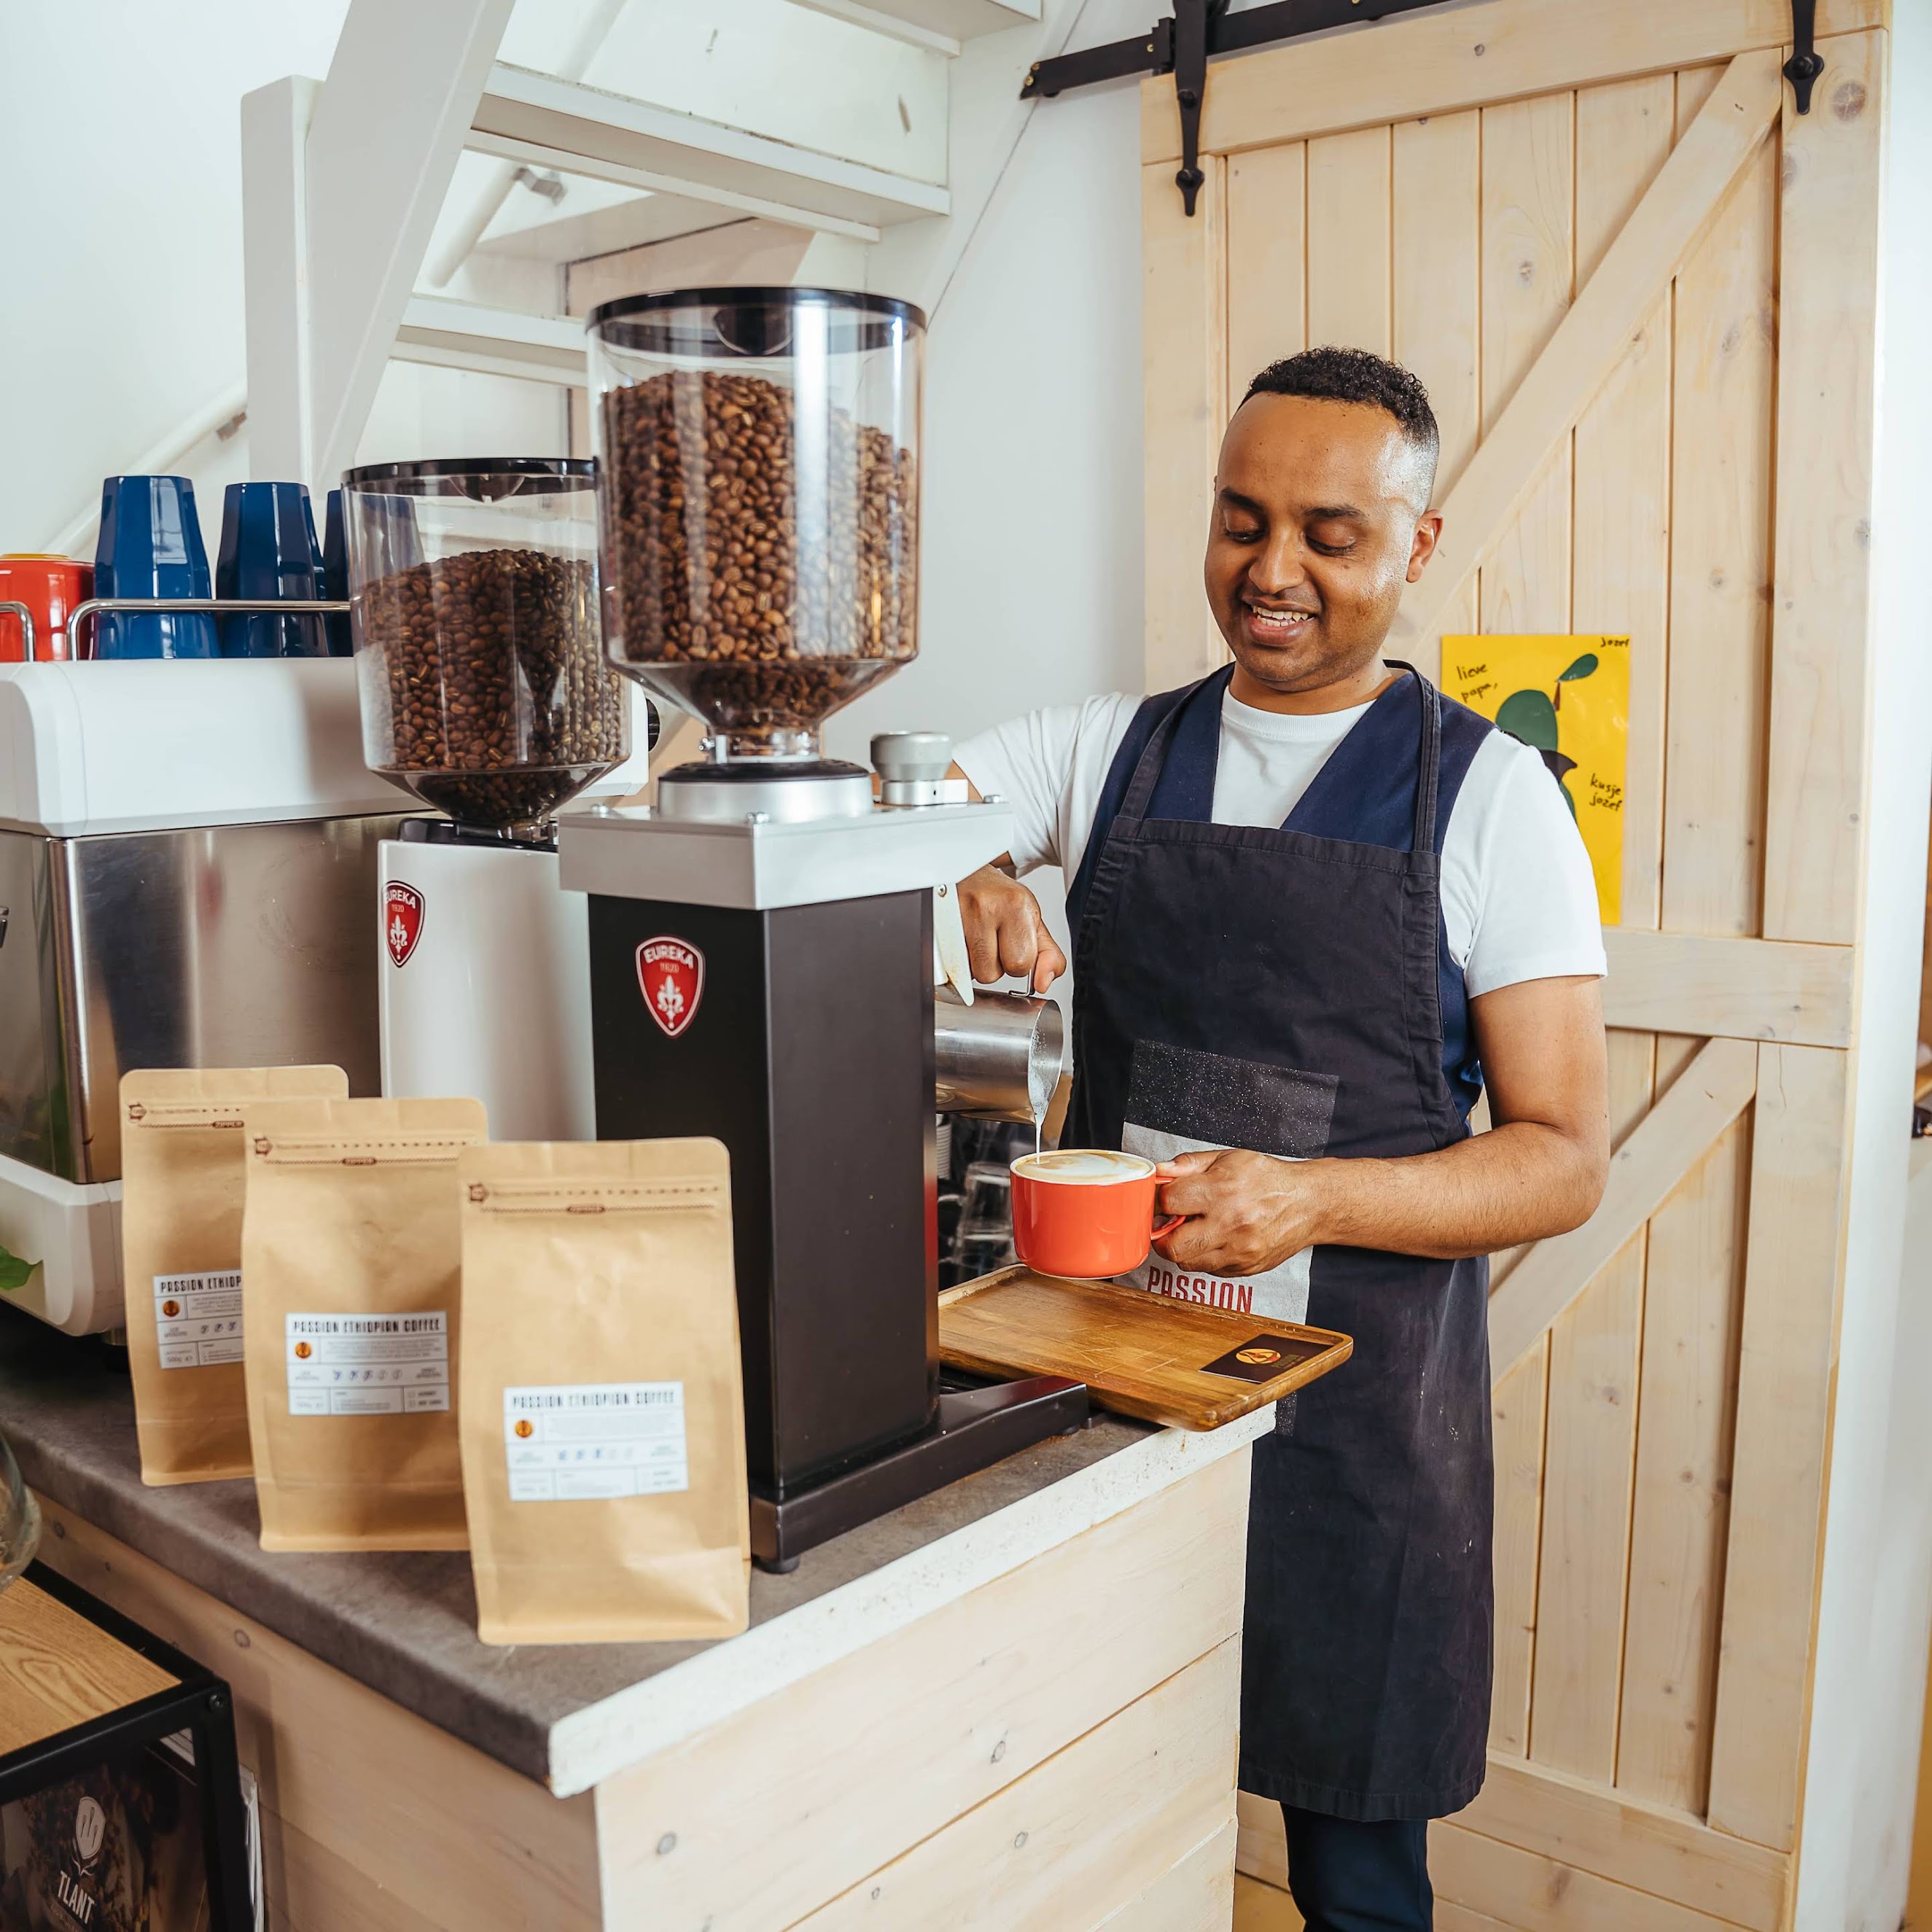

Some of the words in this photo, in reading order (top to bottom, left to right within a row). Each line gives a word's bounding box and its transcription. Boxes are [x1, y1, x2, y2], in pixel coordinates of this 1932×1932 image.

[1457, 664, 1487, 680] lieve
[1590, 773, 1621, 799] kusje
[643, 944, 694, 970] EUREKA
[160, 1279, 203, 1293] PASSION
[1148, 1266, 1253, 1314] PASSION
[295, 1321, 339, 1333] PASSION
[344, 1320, 399, 1333] ETHIOPIAN
[405, 1318, 440, 1331] COFFEE
[513, 1393, 563, 1409] PASSION
[58, 1870, 95, 1924] TLANT
